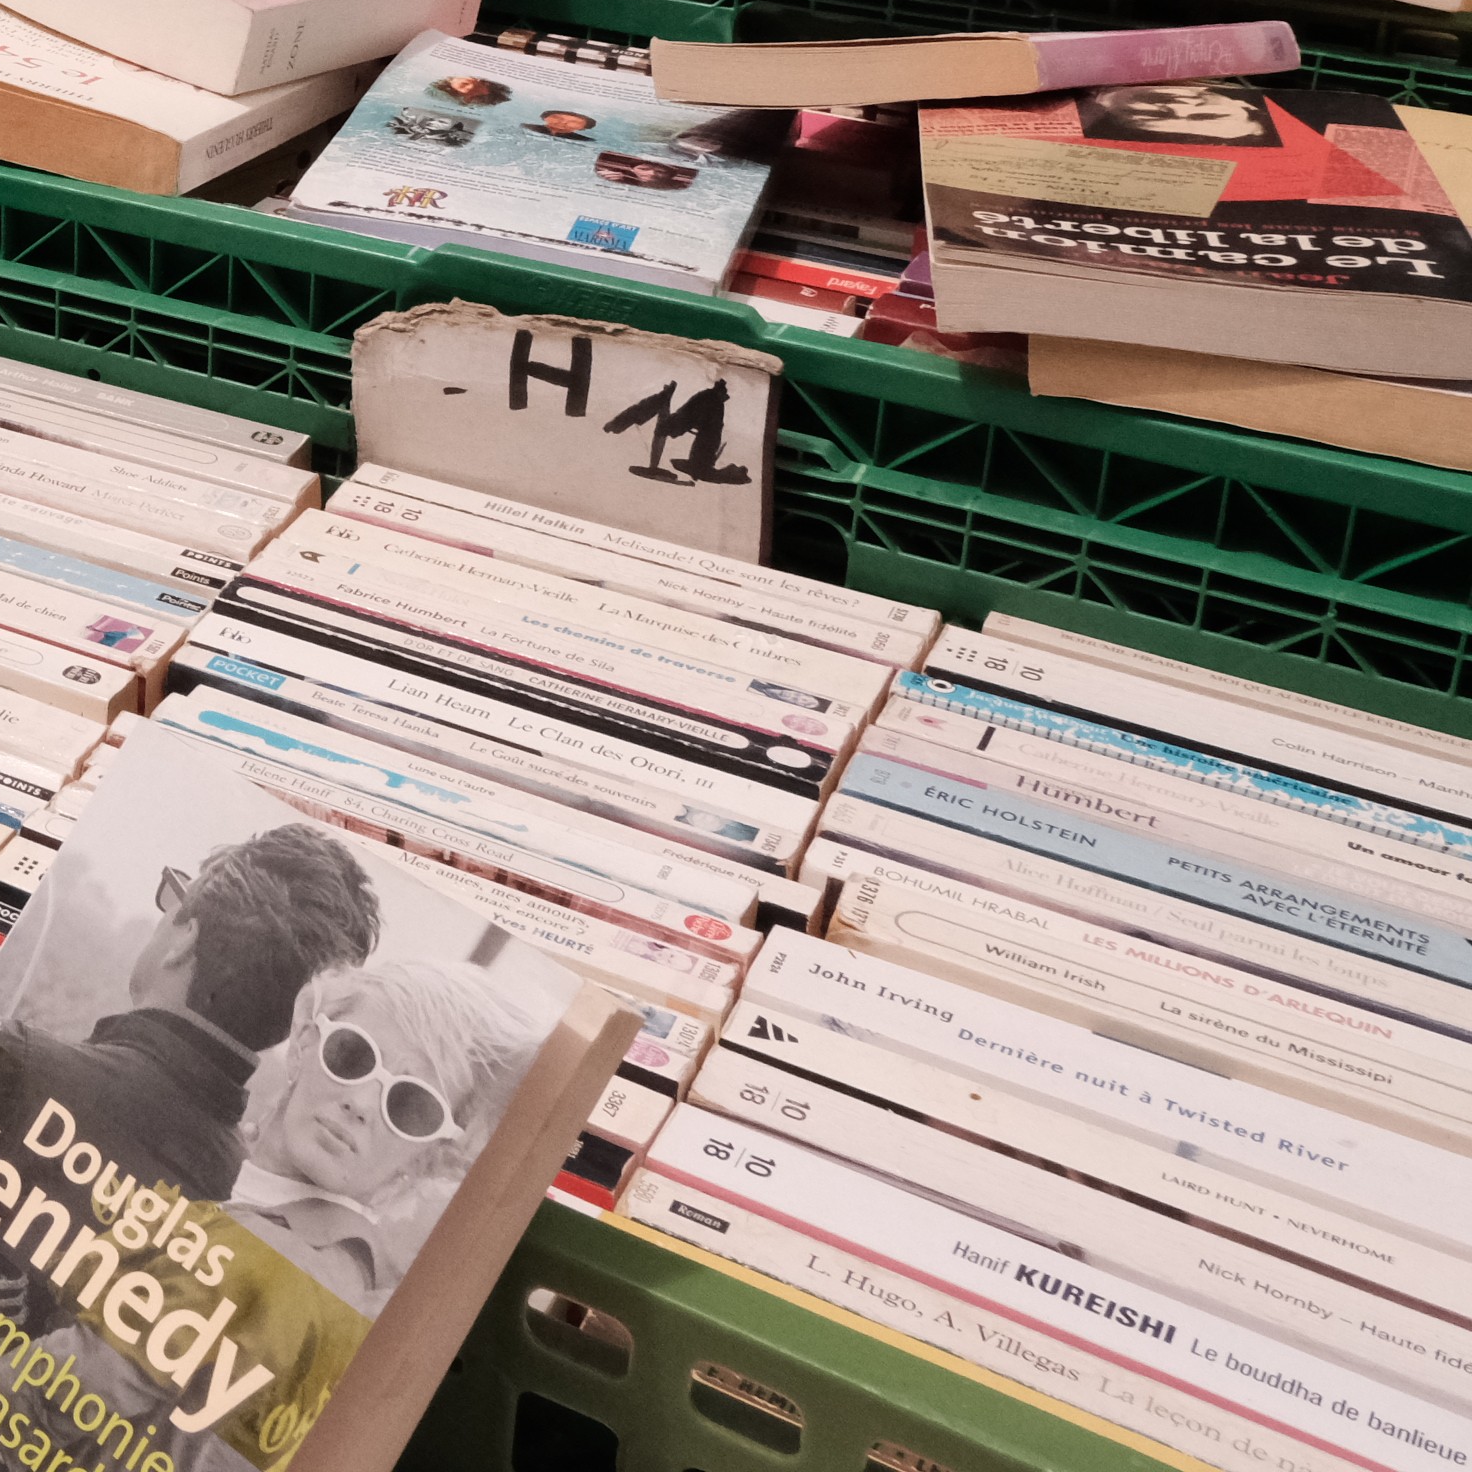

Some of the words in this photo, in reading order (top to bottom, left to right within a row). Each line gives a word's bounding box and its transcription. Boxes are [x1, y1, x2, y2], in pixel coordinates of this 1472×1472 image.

[972, 209, 1234, 247] liberté
[975, 224, 1297, 268] camion
[1241, 231, 1322, 251] la
[1333, 235, 1427, 254] de
[1325, 253, 1446, 280] Le
[510, 331, 592, 416] H
[337, 583, 390, 608] Fabrice
[395, 598, 467, 628] Humbert
[387, 679, 435, 706] Lian
[437, 692, 492, 720] Hearn
[508, 714, 532, 733] Le
[537, 723, 584, 748] Clan
[589, 737, 620, 759] des
[981, 803, 1098, 848] HOLSTEIN
[808, 961, 871, 997] John
[875, 984, 955, 1024] Irving
[958, 1027, 1064, 1076] Dernière
[1074, 1066, 1130, 1101] nuit
[1139, 1087, 1153, 1105] à
[1164, 1097, 1266, 1146] Twisted
[1277, 1136, 1350, 1174] River
[22, 1097, 234, 1288] Douglas
[951, 1239, 1011, 1275] Hanif
[1014, 1262, 1176, 1346] KUREISHI
[1191, 1336, 1220, 1362] Le
[1225, 1348, 1323, 1404] bouddha
[1330, 1394, 1360, 1422] de
[1366, 1409, 1467, 1466] banlieue
